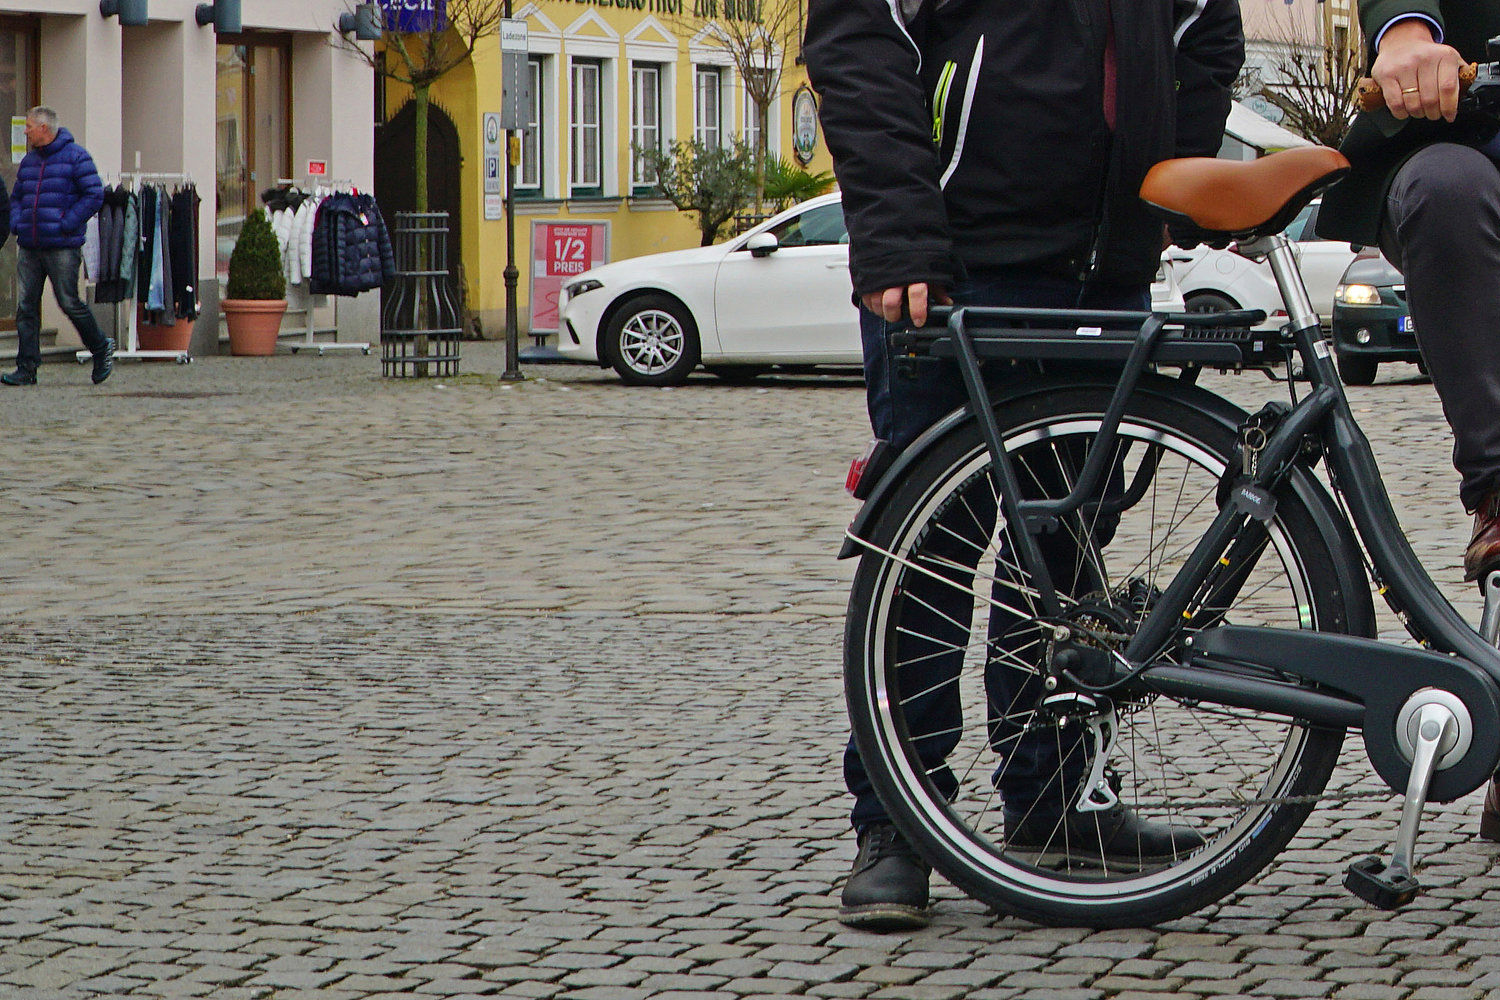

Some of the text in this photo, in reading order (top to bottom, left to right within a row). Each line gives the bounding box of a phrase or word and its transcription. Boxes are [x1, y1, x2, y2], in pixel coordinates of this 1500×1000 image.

[503, 31, 526, 40] Ladezone
[554, 237, 585, 261] 1/2
[554, 261, 585, 273] PREIS
